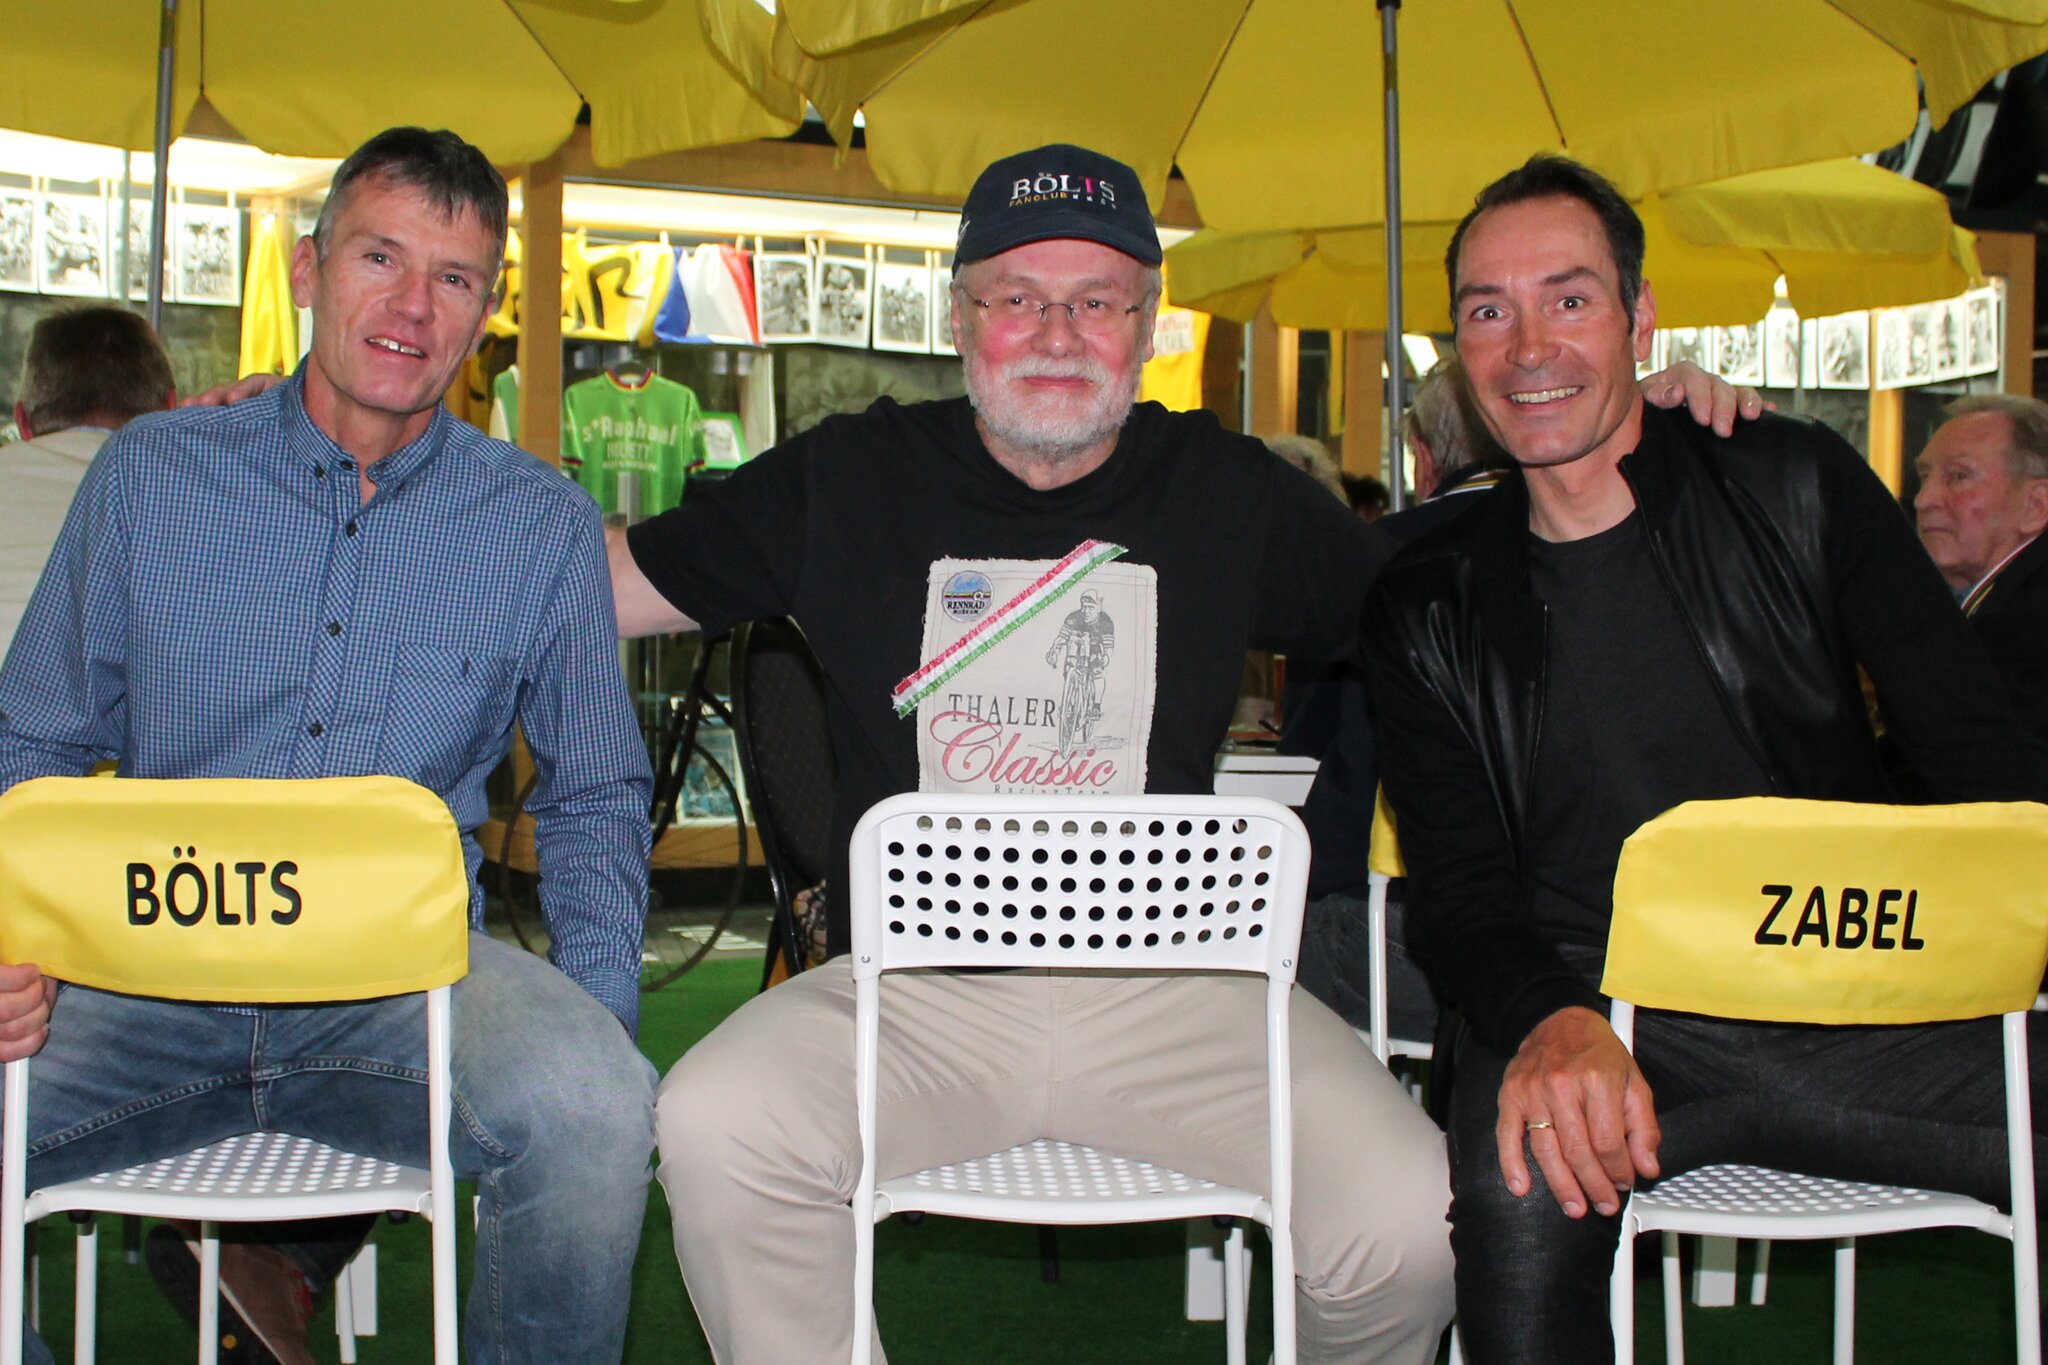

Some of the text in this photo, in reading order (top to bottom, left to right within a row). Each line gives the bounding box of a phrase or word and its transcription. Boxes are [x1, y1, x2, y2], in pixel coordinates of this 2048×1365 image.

[1009, 191, 1068, 208] FANCLUB
[1011, 172, 1115, 202] BÖLTS
[947, 600, 985, 610] RENNRAD
[949, 694, 1056, 728] THALER
[929, 710, 1117, 787] Classic
[126, 845, 302, 927] BÖLTS
[1754, 884, 1925, 951] ZABEL
